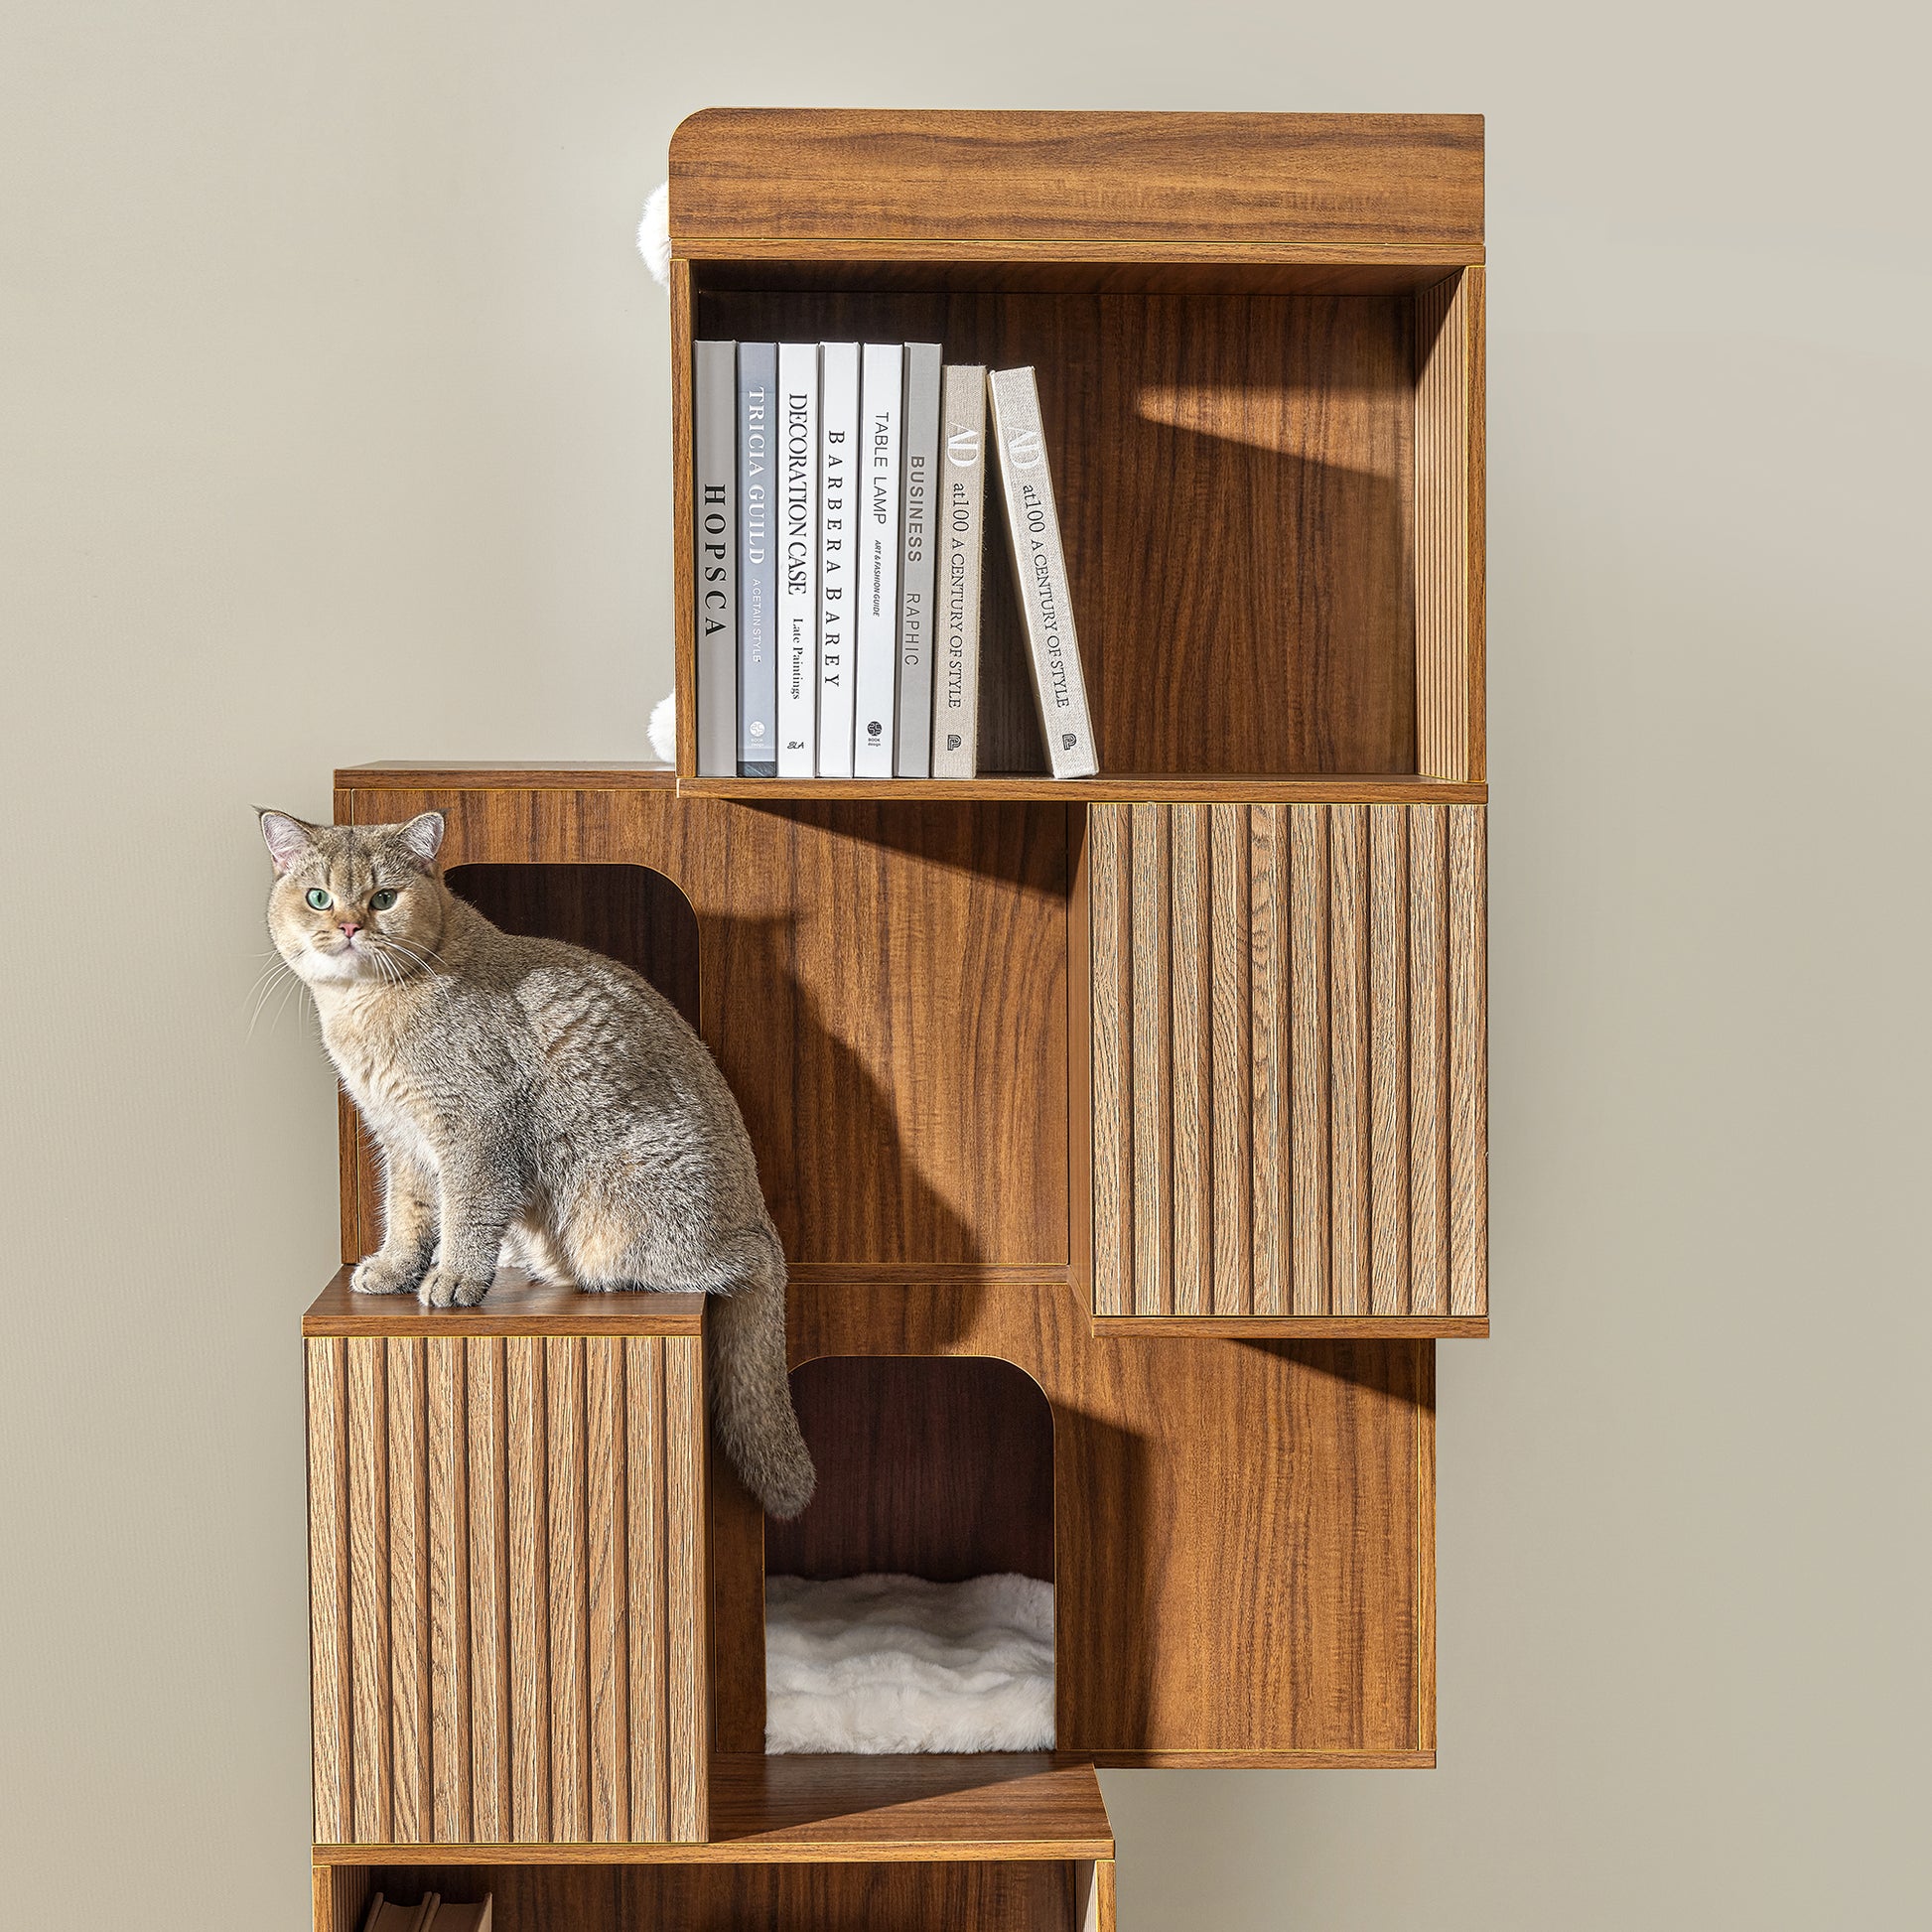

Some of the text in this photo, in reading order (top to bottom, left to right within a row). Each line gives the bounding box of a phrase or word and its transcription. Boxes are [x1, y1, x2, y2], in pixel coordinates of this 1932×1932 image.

[749, 386, 765, 565] TRICIA GUILD
[787, 393, 808, 596] DECORATION CASE
[873, 412, 890, 525] TABLE LAMP
[946, 421, 979, 468] AD
[1006, 425, 1041, 470] AD
[704, 483, 727, 637] HOPSCA
[824, 430, 845, 687] BARBERA BAREY
[904, 456, 925, 666] BUSINESS RAPHIC
[948, 483, 970, 709] at100 A CENTURY OF STYLE
[1023, 484, 1070, 709] at100 A CENTURY OF STYLE
[789, 619, 804, 700] Late Paintings
